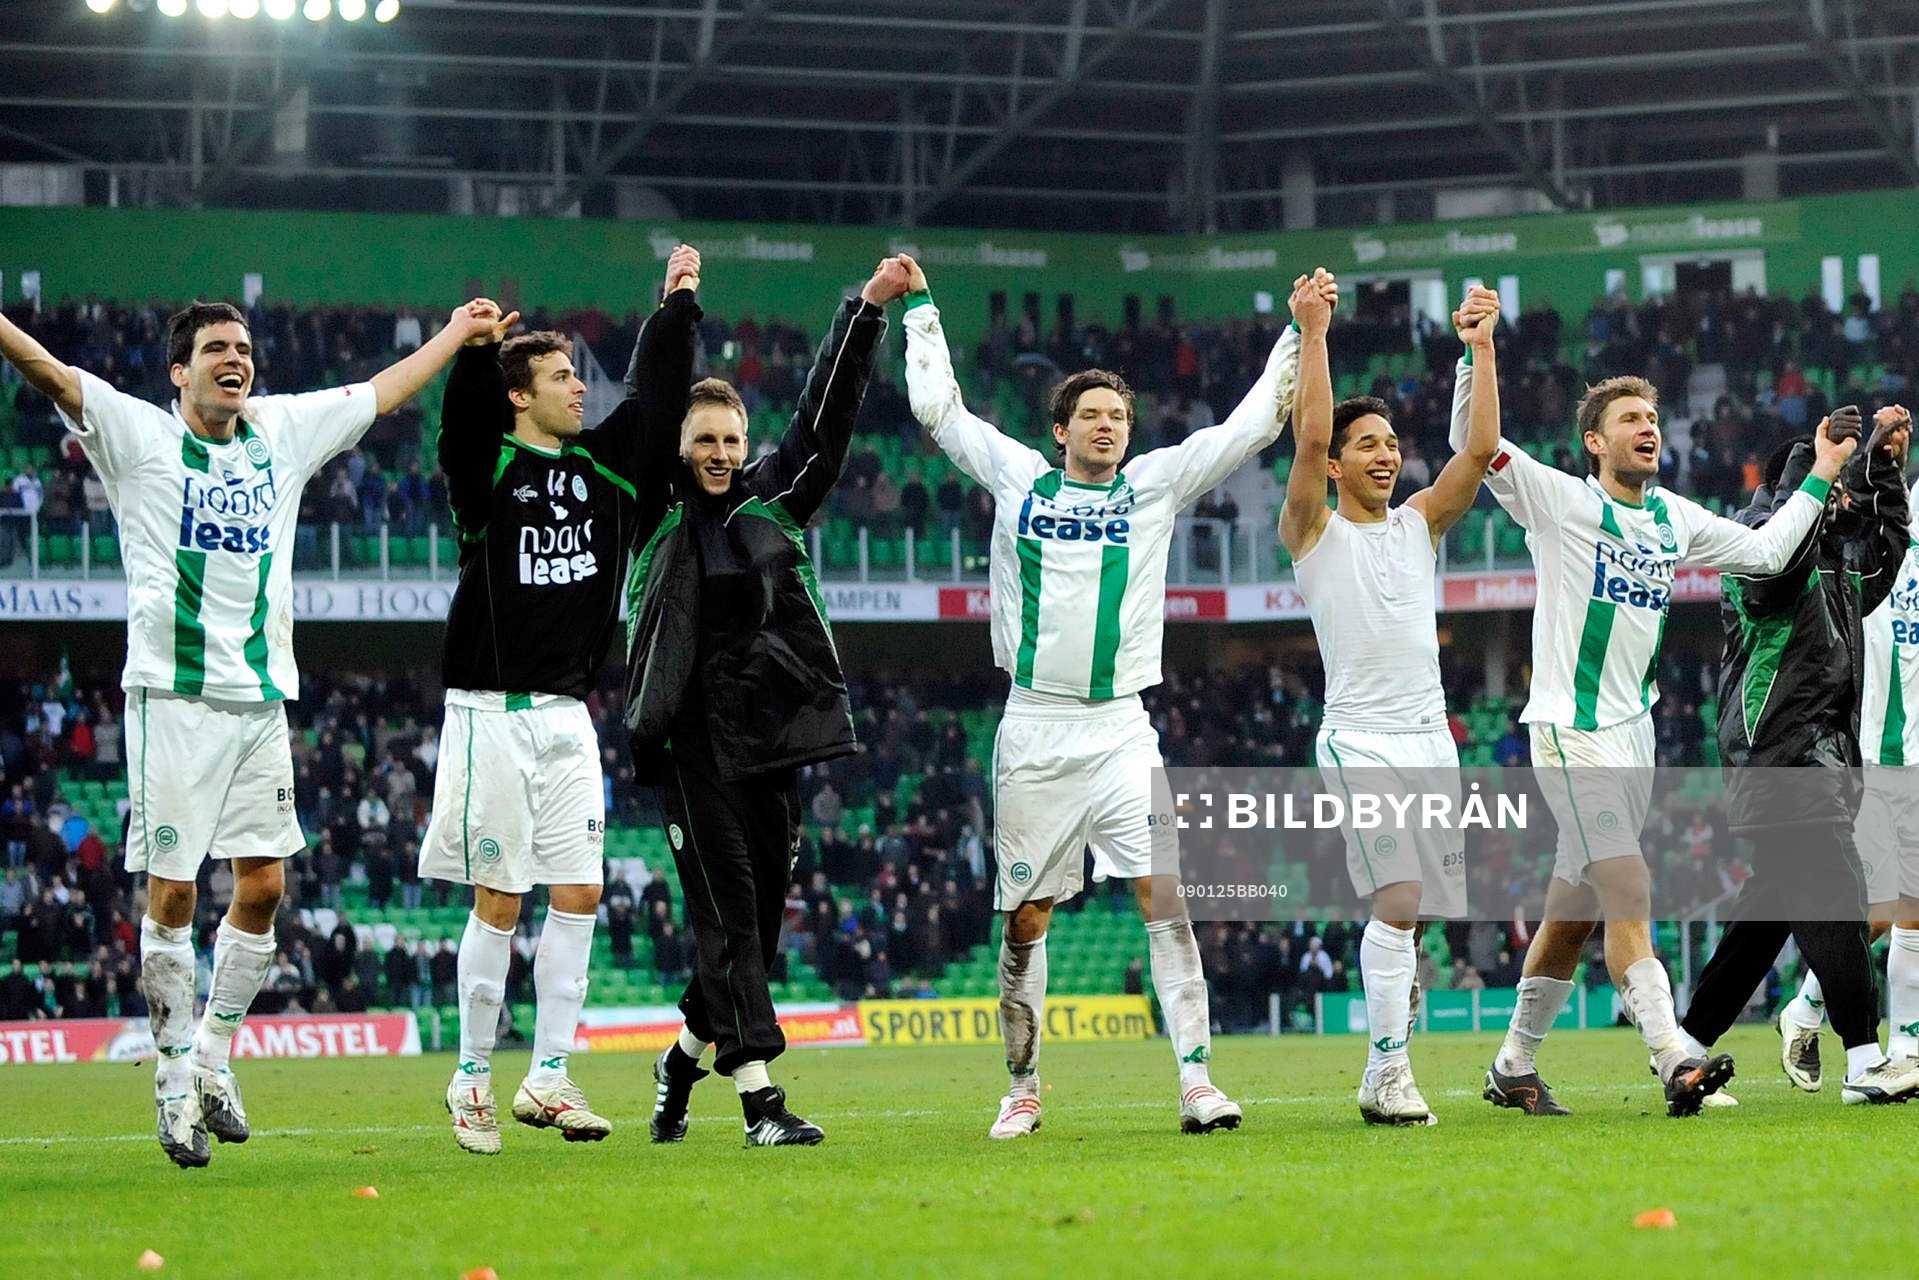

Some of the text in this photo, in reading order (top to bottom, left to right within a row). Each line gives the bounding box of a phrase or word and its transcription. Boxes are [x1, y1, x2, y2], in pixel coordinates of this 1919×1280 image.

[1018, 497, 1128, 544] lease
[518, 550, 598, 585] lease
[234, 1022, 388, 1057] AMSTEL
[868, 1007, 964, 1043] SPORT
